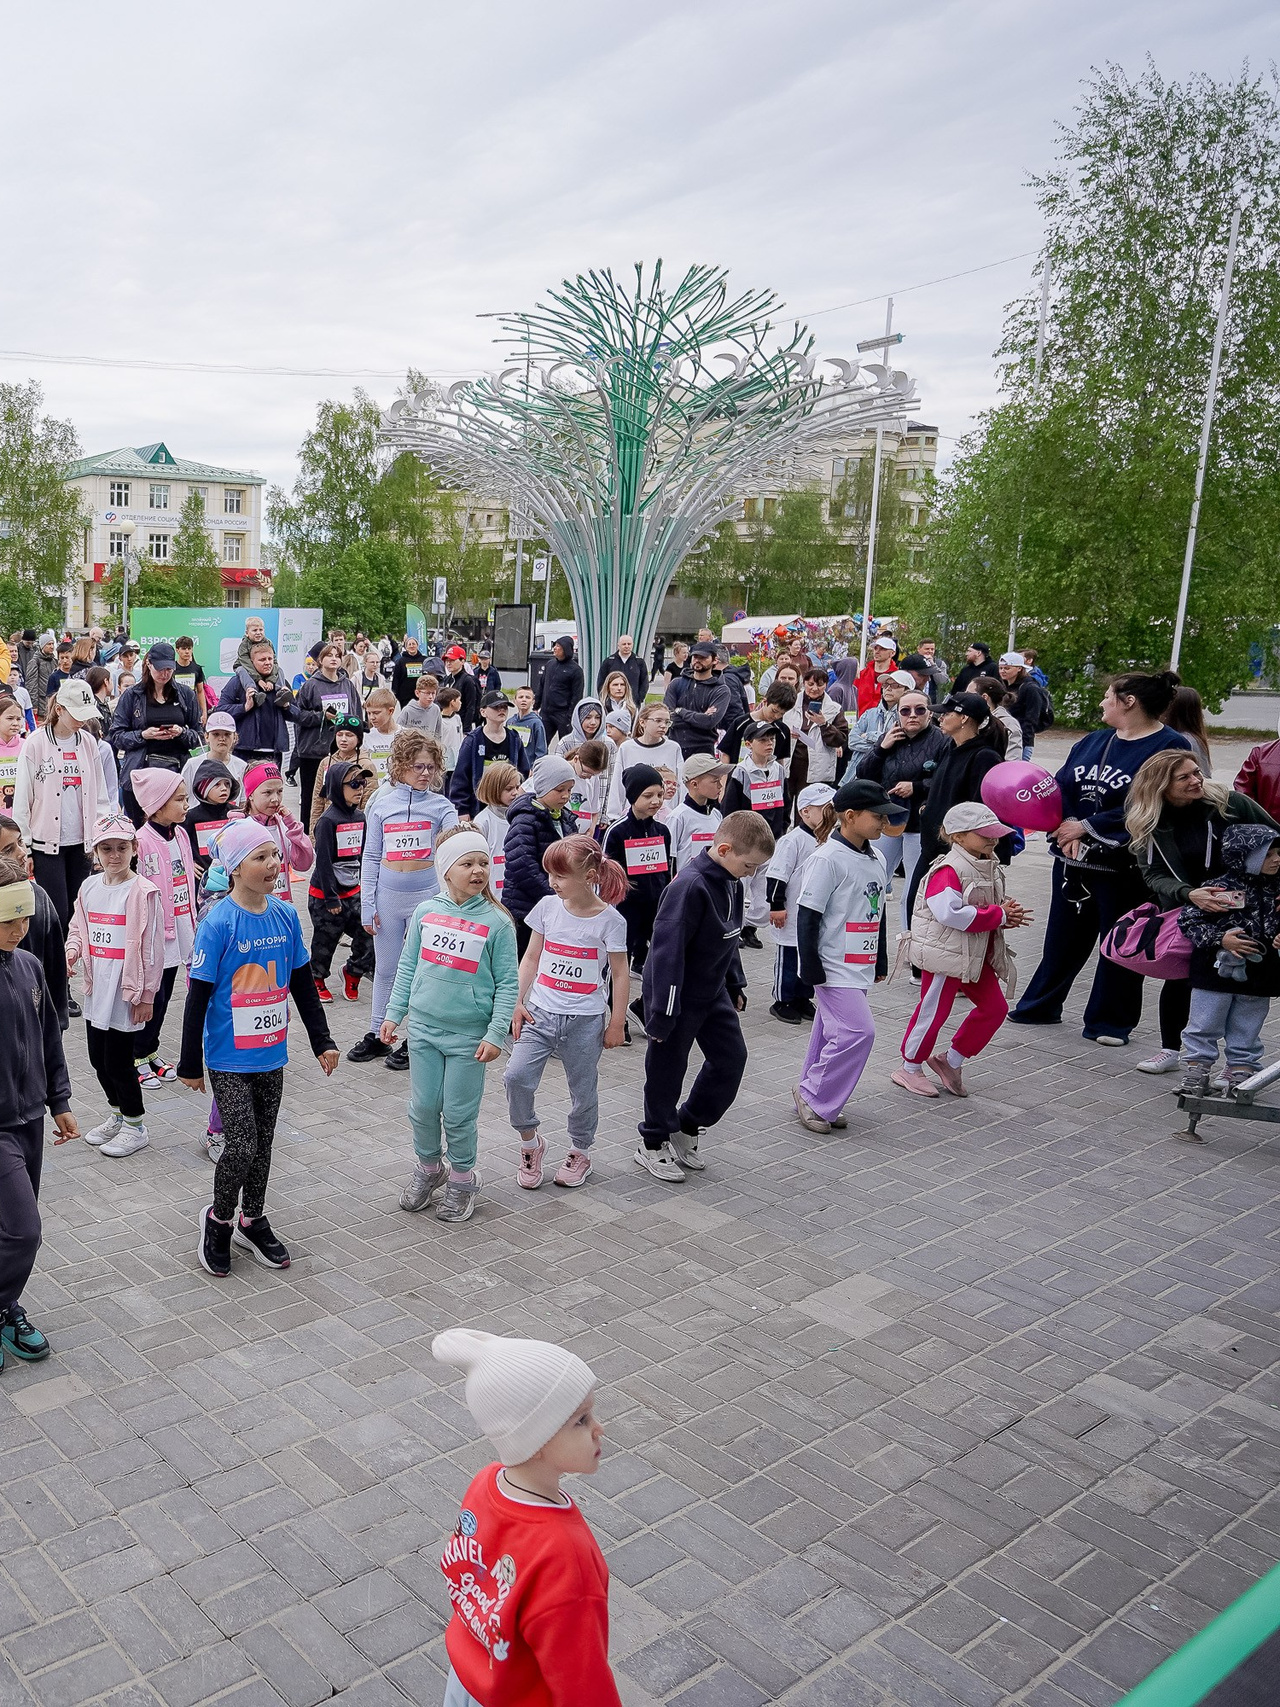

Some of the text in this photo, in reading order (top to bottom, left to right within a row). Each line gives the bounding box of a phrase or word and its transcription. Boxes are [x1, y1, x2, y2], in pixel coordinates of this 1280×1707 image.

[140, 636, 200, 646] ВЗРОСЙ
[82, 691, 91, 704] LA
[64, 765, 79, 774] 816
[1073, 764, 1131, 790] PARIS
[1031, 775, 1054, 793] СБЕР
[395, 837, 419, 848] 2971
[640, 852, 660, 862] 2647
[174, 889, 190, 904] 260
[92, 931, 112, 944] 2813
[254, 935, 287, 947] ЮГОРИЯ
[431, 934, 465, 953] 2961
[434, 953, 452, 965] 400м
[550, 963, 582, 978] 2740
[554, 980, 572, 990] 400м
[254, 1014, 282, 1030] 2804
